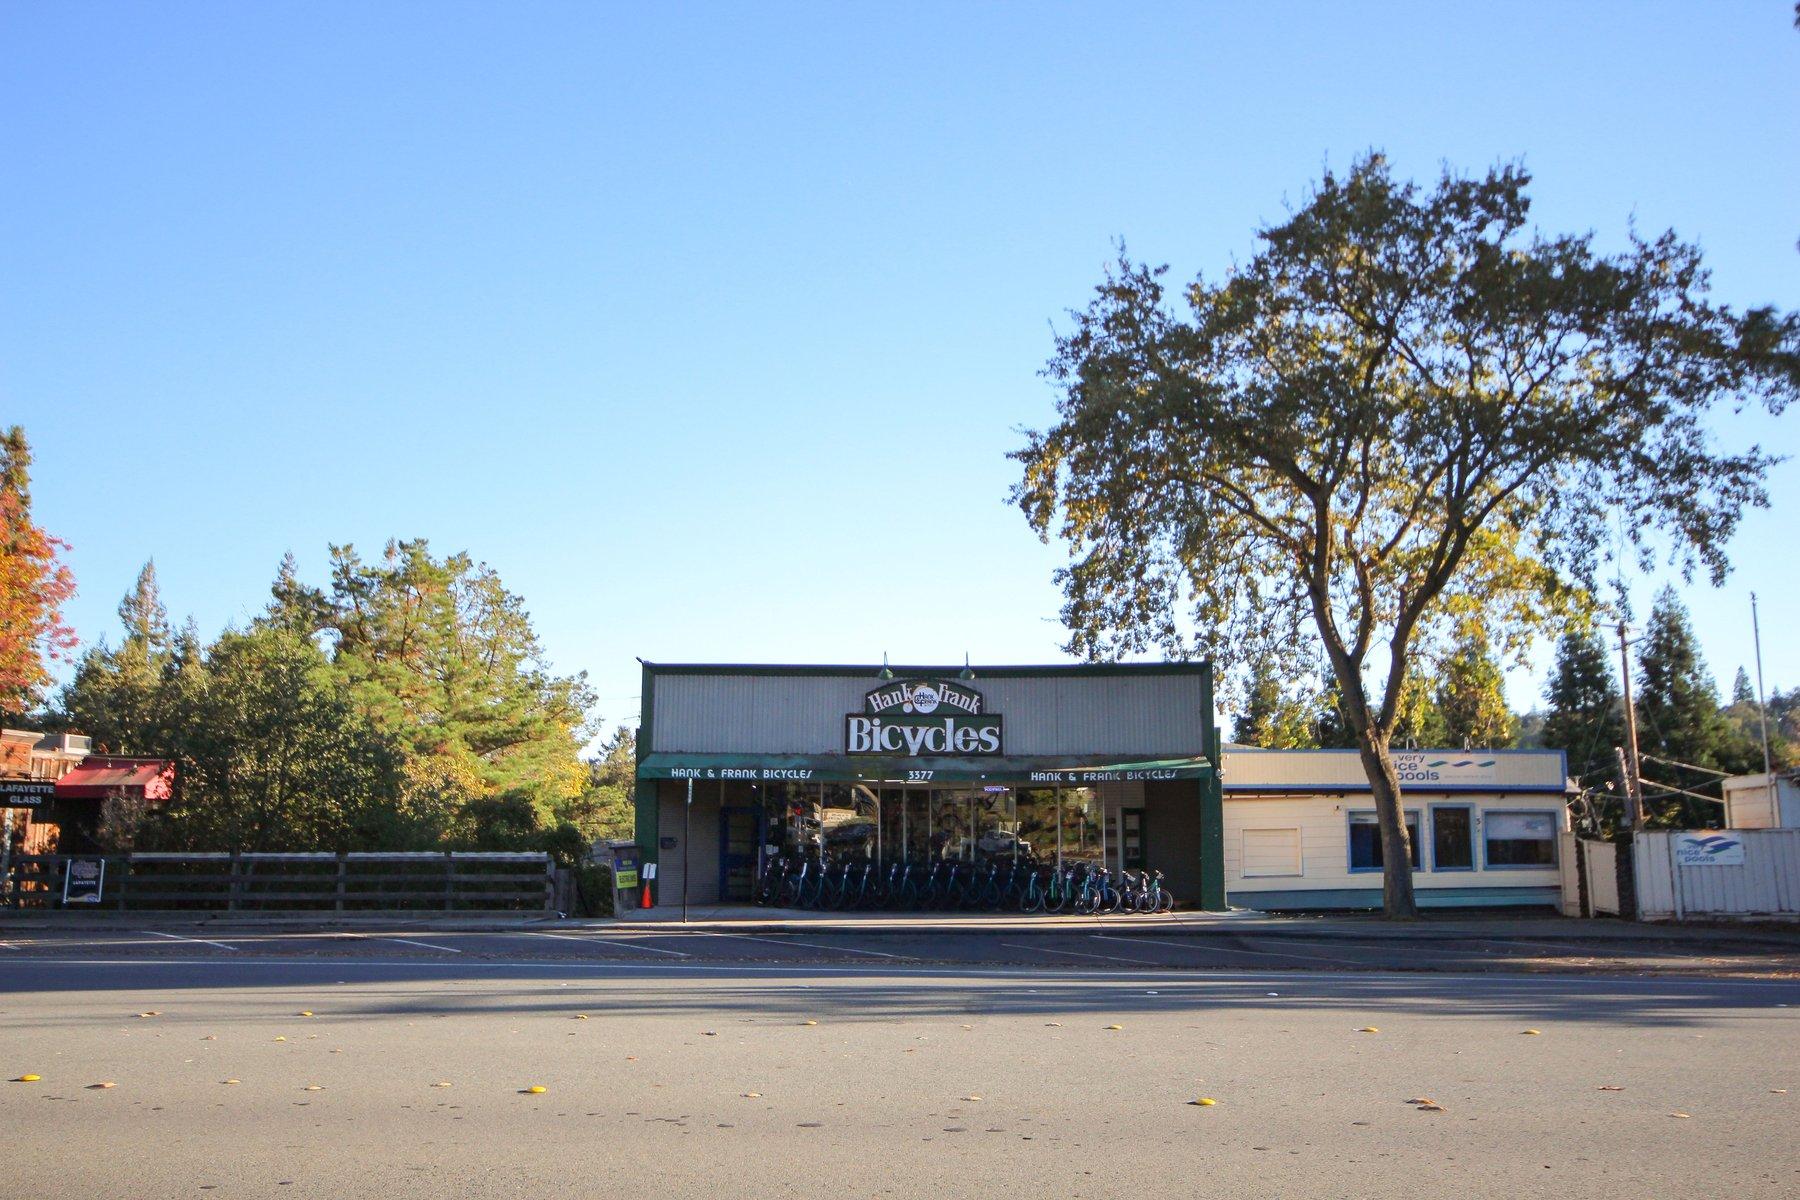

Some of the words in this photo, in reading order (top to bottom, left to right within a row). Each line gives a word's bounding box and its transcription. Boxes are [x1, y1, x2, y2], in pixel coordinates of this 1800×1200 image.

[868, 683, 913, 713] Hank
[938, 683, 981, 714] Frank
[847, 717, 1000, 756] Bicycles
[1398, 754, 1426, 763] very
[1393, 761, 1418, 771] ice
[671, 768, 701, 778] HANK
[707, 769, 715, 778] &
[721, 769, 757, 778] FRANK
[763, 769, 813, 779] BICYCLES
[908, 771, 934, 780] 3377
[1031, 771, 1062, 781] HANK
[1068, 772, 1077, 782] &
[1083, 772, 1121, 781] FRANK
[1126, 769, 1178, 781] BICYCLES
[0, 784, 55, 793] LAFAYETTE
[10, 795, 42, 804] GLASS
